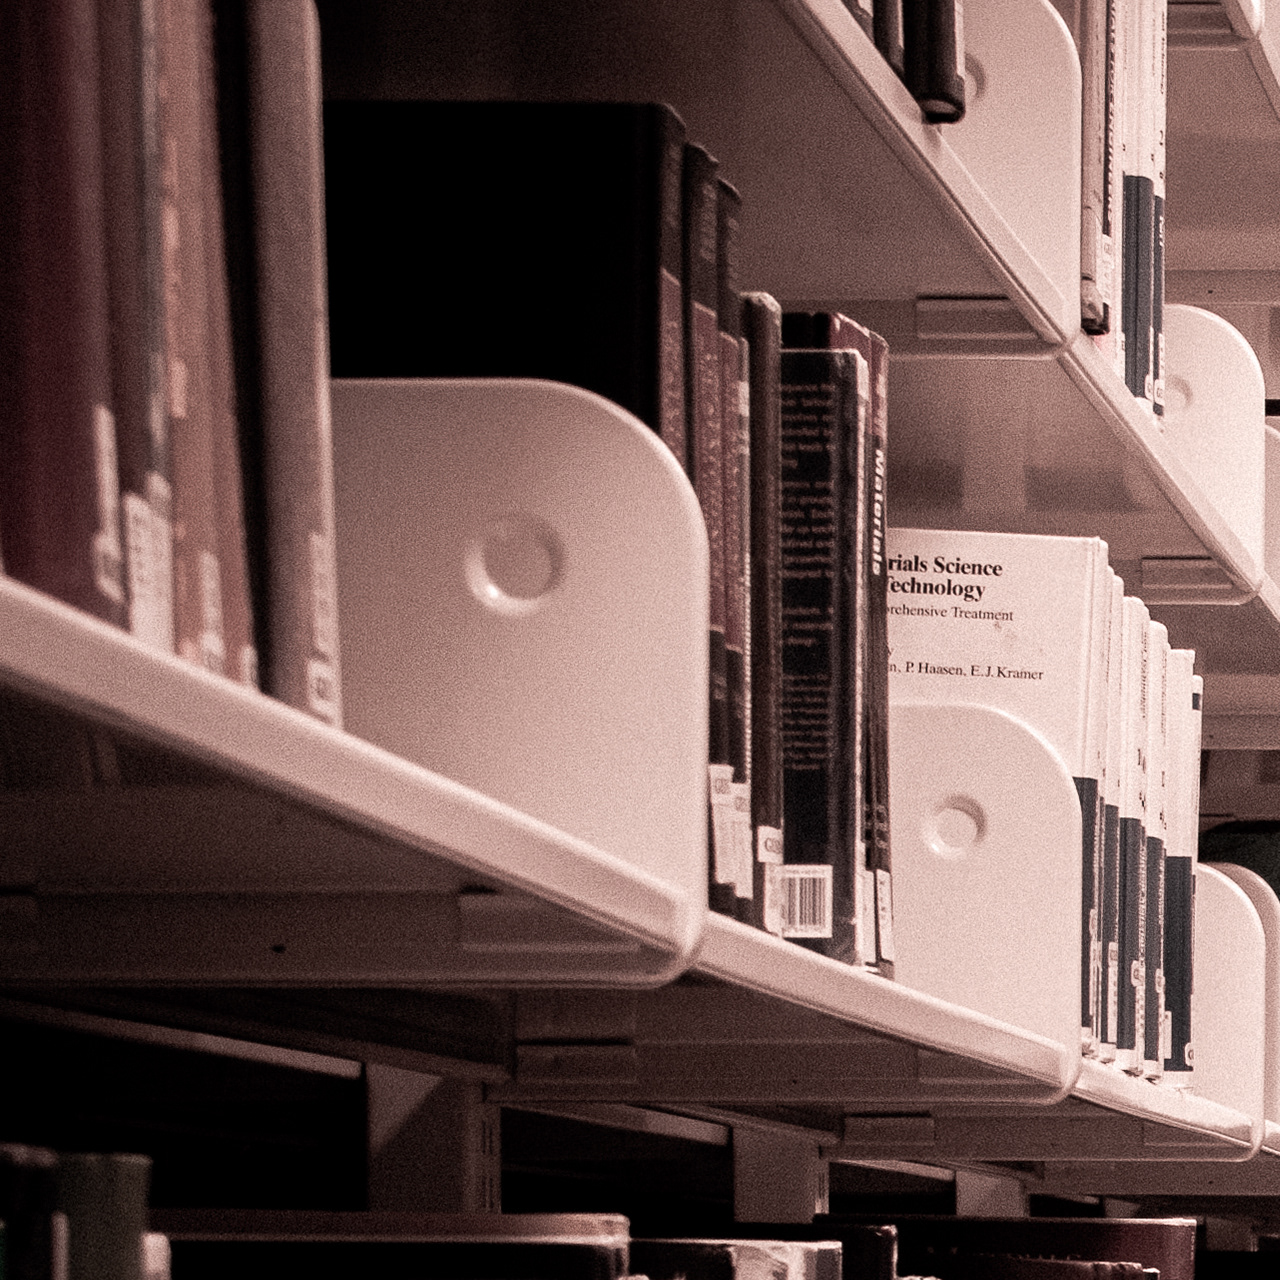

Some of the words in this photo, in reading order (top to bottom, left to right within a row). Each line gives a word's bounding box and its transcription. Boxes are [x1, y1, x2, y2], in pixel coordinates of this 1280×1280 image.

[871, 449, 885, 575] Materials
[887, 554, 928, 574] rials
[933, 556, 1003, 577] Science
[951, 606, 1014, 622] Treatment
[918, 662, 967, 677] Haasen,
[997, 666, 1044, 681] Kramer
